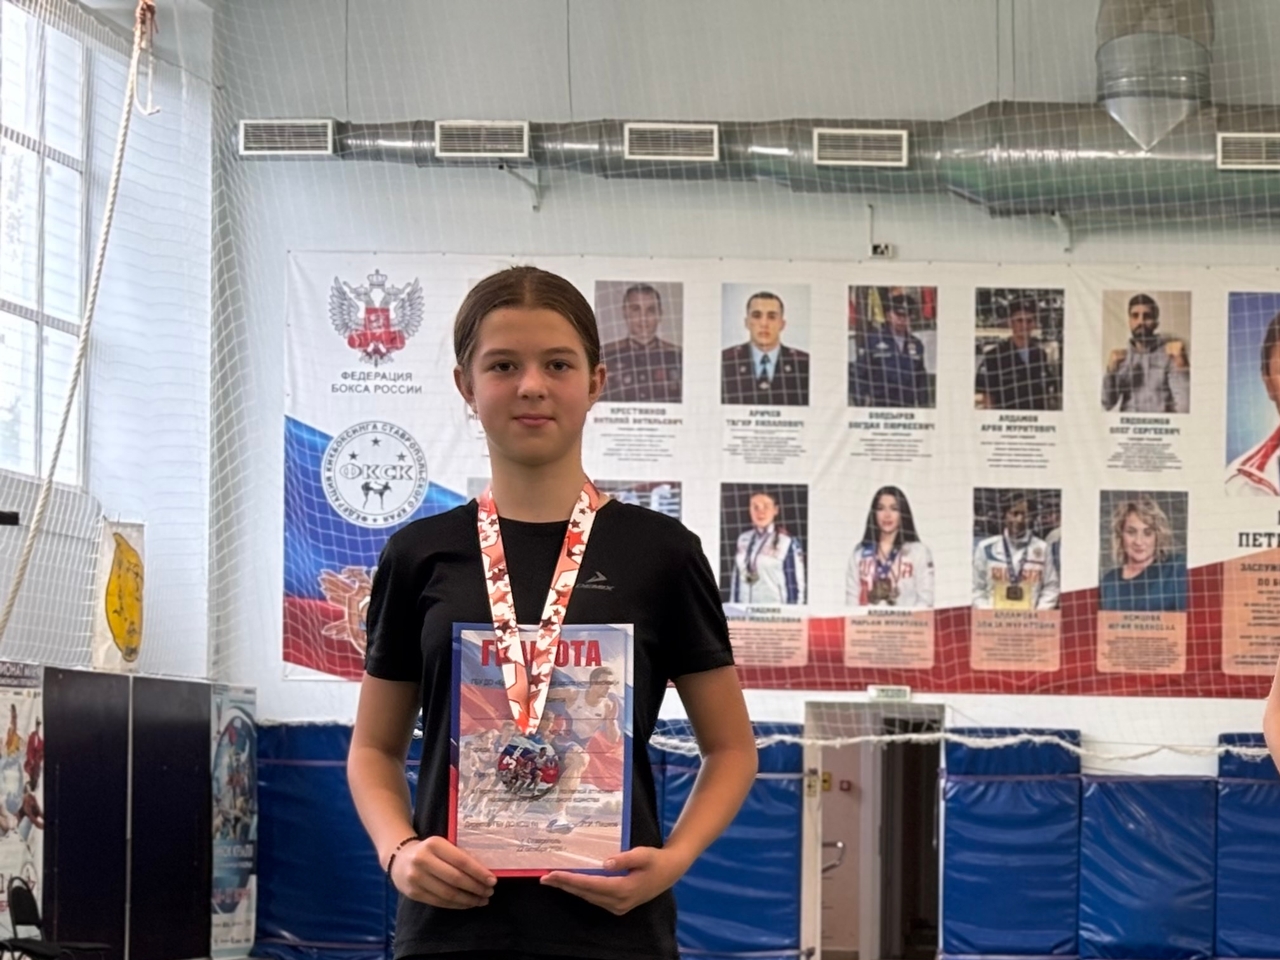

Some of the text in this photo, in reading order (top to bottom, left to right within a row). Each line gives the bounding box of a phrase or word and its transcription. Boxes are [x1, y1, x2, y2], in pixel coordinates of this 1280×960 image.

[341, 372, 412, 382] ФЕДЕРАЦИЯ
[331, 384, 422, 394] БОКСА РОССИИ
[326, 424, 378, 472] КИКБОКСИНГА
[382, 424, 426, 508] СТАВРОПОЛЬСКОГО
[339, 463, 414, 481] ФКСК
[1258, 578, 1270, 586] ПО
